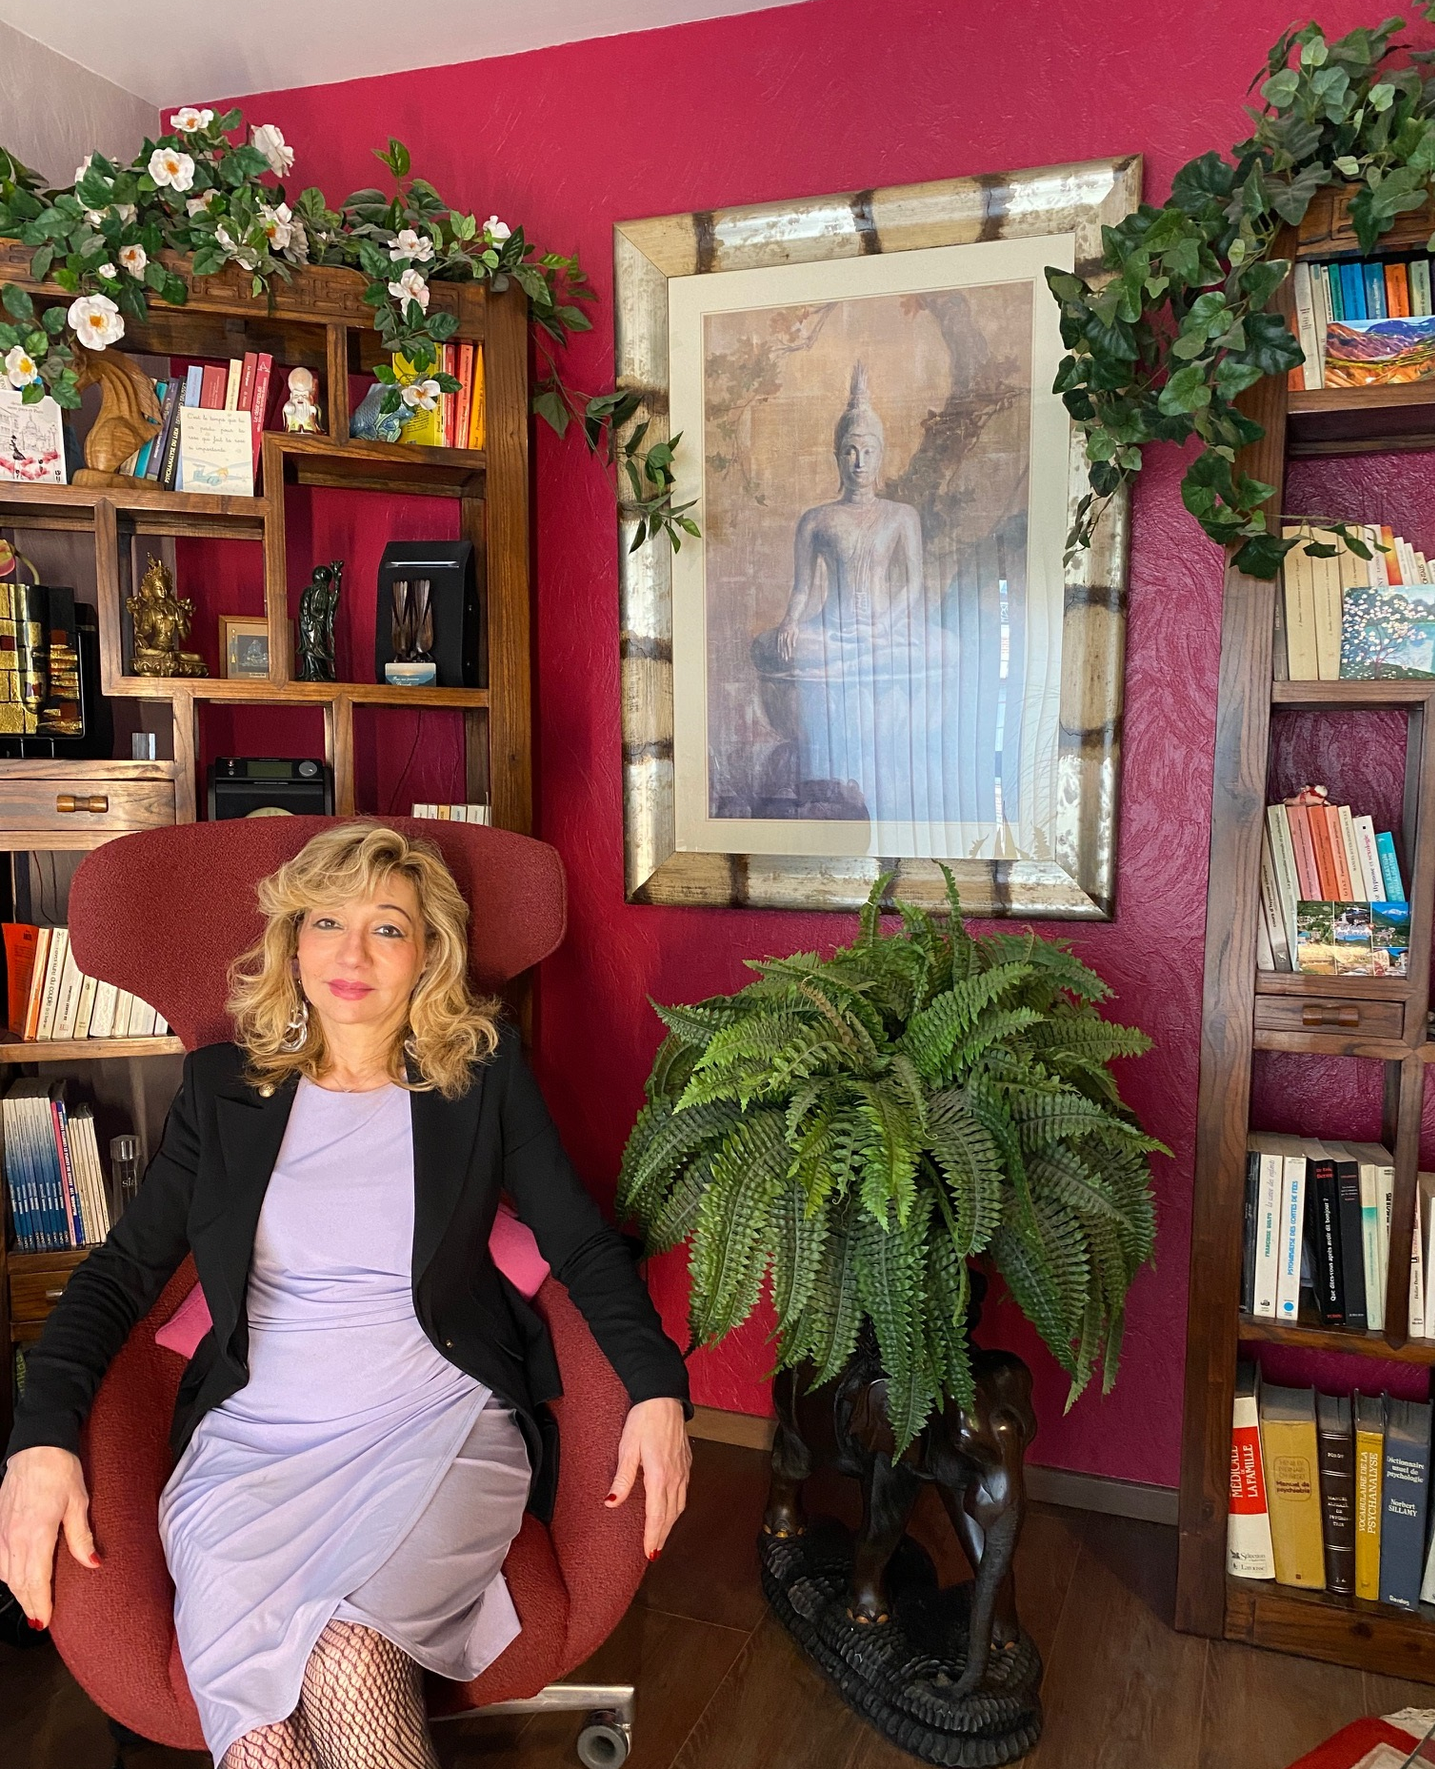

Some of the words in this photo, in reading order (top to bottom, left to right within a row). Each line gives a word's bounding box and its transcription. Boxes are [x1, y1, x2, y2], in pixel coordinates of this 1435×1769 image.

[164, 447, 177, 483] PSYCHANALYSE
[1363, 834, 1372, 860] sexologie
[1282, 860, 1291, 883] personnalité
[1370, 868, 1379, 892] Hypnose
[1382, 854, 1395, 894] RELAXATION
[1388, 853, 1401, 895] VISUALISATION
[1265, 886, 1274, 913] d'hypnose
[50, 976, 56, 985] du
[46, 986, 55, 1006] couple
[63, 1152, 71, 1165] COUPLE
[1291, 1195, 1297, 1203] DE
[1287, 1238, 1296, 1276] PSYCHANALYSE
[1327, 1262, 1335, 1289] dites-vous
[1243, 1444, 1257, 1484] FAMILLE
[1361, 1452, 1368, 1462] LA
[1387, 1456, 1424, 1469] Dictionnaire
[1229, 1446, 1243, 1498] MÉDICALE
[1361, 1463, 1367, 1475] DE
[1387, 1471, 1423, 1483] psychologie
[1392, 1465, 1409, 1473] usuel
[1247, 1485, 1258, 1497] LA
[1367, 1453, 1378, 1534] PSYCHANALYSE
[1388, 1505, 1417, 1517] SILLAMY
[1390, 1498, 1415, 1509] Norbert
[1241, 1552, 1265, 1560] Sélection
